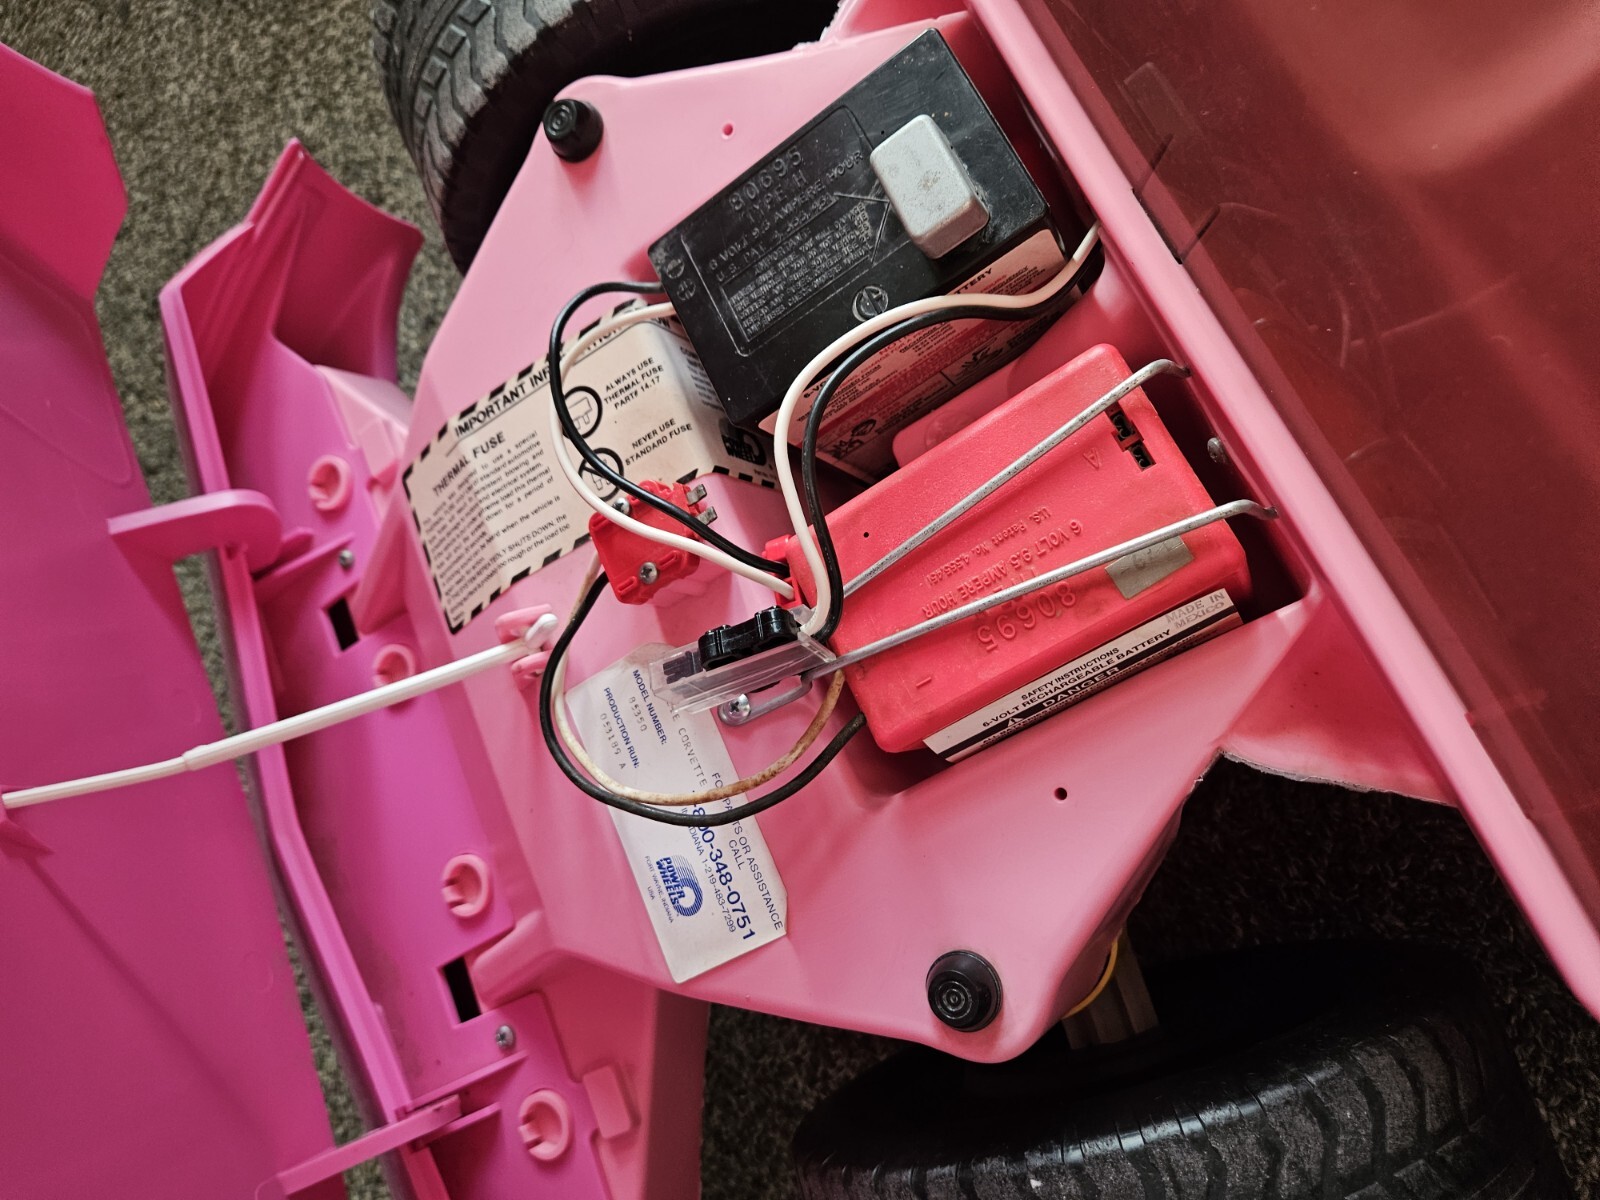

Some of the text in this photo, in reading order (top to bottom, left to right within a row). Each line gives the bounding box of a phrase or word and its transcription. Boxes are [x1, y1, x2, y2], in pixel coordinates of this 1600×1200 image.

[771, 177, 827, 223] AMPERE
[825, 149, 865, 184] HOUR
[953, 268, 993, 296] TTERY
[603, 363, 664, 405] THERMAL FUSE
[604, 355, 654, 392] ALWAYS USE
[613, 374, 662, 410] PART# 14.17
[452, 381, 530, 438] IMPORTANT
[514, 429, 538, 450] special
[623, 421, 693, 466] STANDARD FUSE
[630, 417, 676, 449] NEVER USE
[432, 453, 470, 497] THERMAL
[470, 430, 507, 459] FUSE
[478, 461, 508, 481] standard
[506, 439, 542, 465] automotive
[503, 457, 530, 478] blowing
[530, 448, 545, 460] and
[490, 475, 519, 496] electrical
[499, 489, 514, 502] load
[513, 481, 526, 493] this
[525, 465, 552, 485] thermal
[504, 500, 515, 510] for
[523, 481, 545, 499] period
[545, 474, 555, 484] of
[500, 519, 519, 534] when
[518, 512, 530, 523] the
[529, 498, 554, 516] vehicle
[553, 493, 561, 502] is
[506, 533, 532, 552] SHUTS
[555, 512, 567, 523] the
[1027, 504, 1051, 528] U.S.
[1066, 517, 1085, 538] 6
[506, 548, 527, 564] rough
[525, 543, 534, 552] or
[532, 537, 545, 548] the
[543, 528, 560, 542] load
[558, 521, 571, 533] too
[969, 540, 990, 560] No.
[989, 518, 1027, 549] Patent
[1031, 525, 1070, 558] VOLT
[1006, 545, 1034, 571] 9.5
[955, 558, 1011, 602] AMPERE
[919, 589, 958, 620] HOUR
[972, 578, 1078, 655] 80695
[1164, 590, 1225, 624] MADE IN
[1173, 599, 1226, 630] MEXICO
[981, 704, 1021, 727] 6-VOLT
[1020, 656, 1115, 708] RECHARGEABLE
[1115, 628, 1172, 661] BATTERY
[1020, 680, 1054, 701] SAFETY
[1054, 646, 1120, 683] INSTRUCTIONS
[1042, 665, 1119, 708] DANGER
[631, 668, 668, 745] MODEL NUMBER:
[602, 686, 641, 769] PRODUCTION RUN:
[676, 726, 708, 787] CORVETTE
[643, 854, 655, 873] FORT
[721, 797, 743, 835] PATS
[737, 835, 752, 855] OR
[745, 854, 784, 931] ASSISTANCE
[727, 838, 746, 871] CALL
[646, 885, 656, 901] USA
[654, 858, 679, 906] WHEELS
[661, 854, 687, 900] POWER
[686, 822, 705, 856] DIANA
[700, 858, 737, 933] 1-219-483-7299
